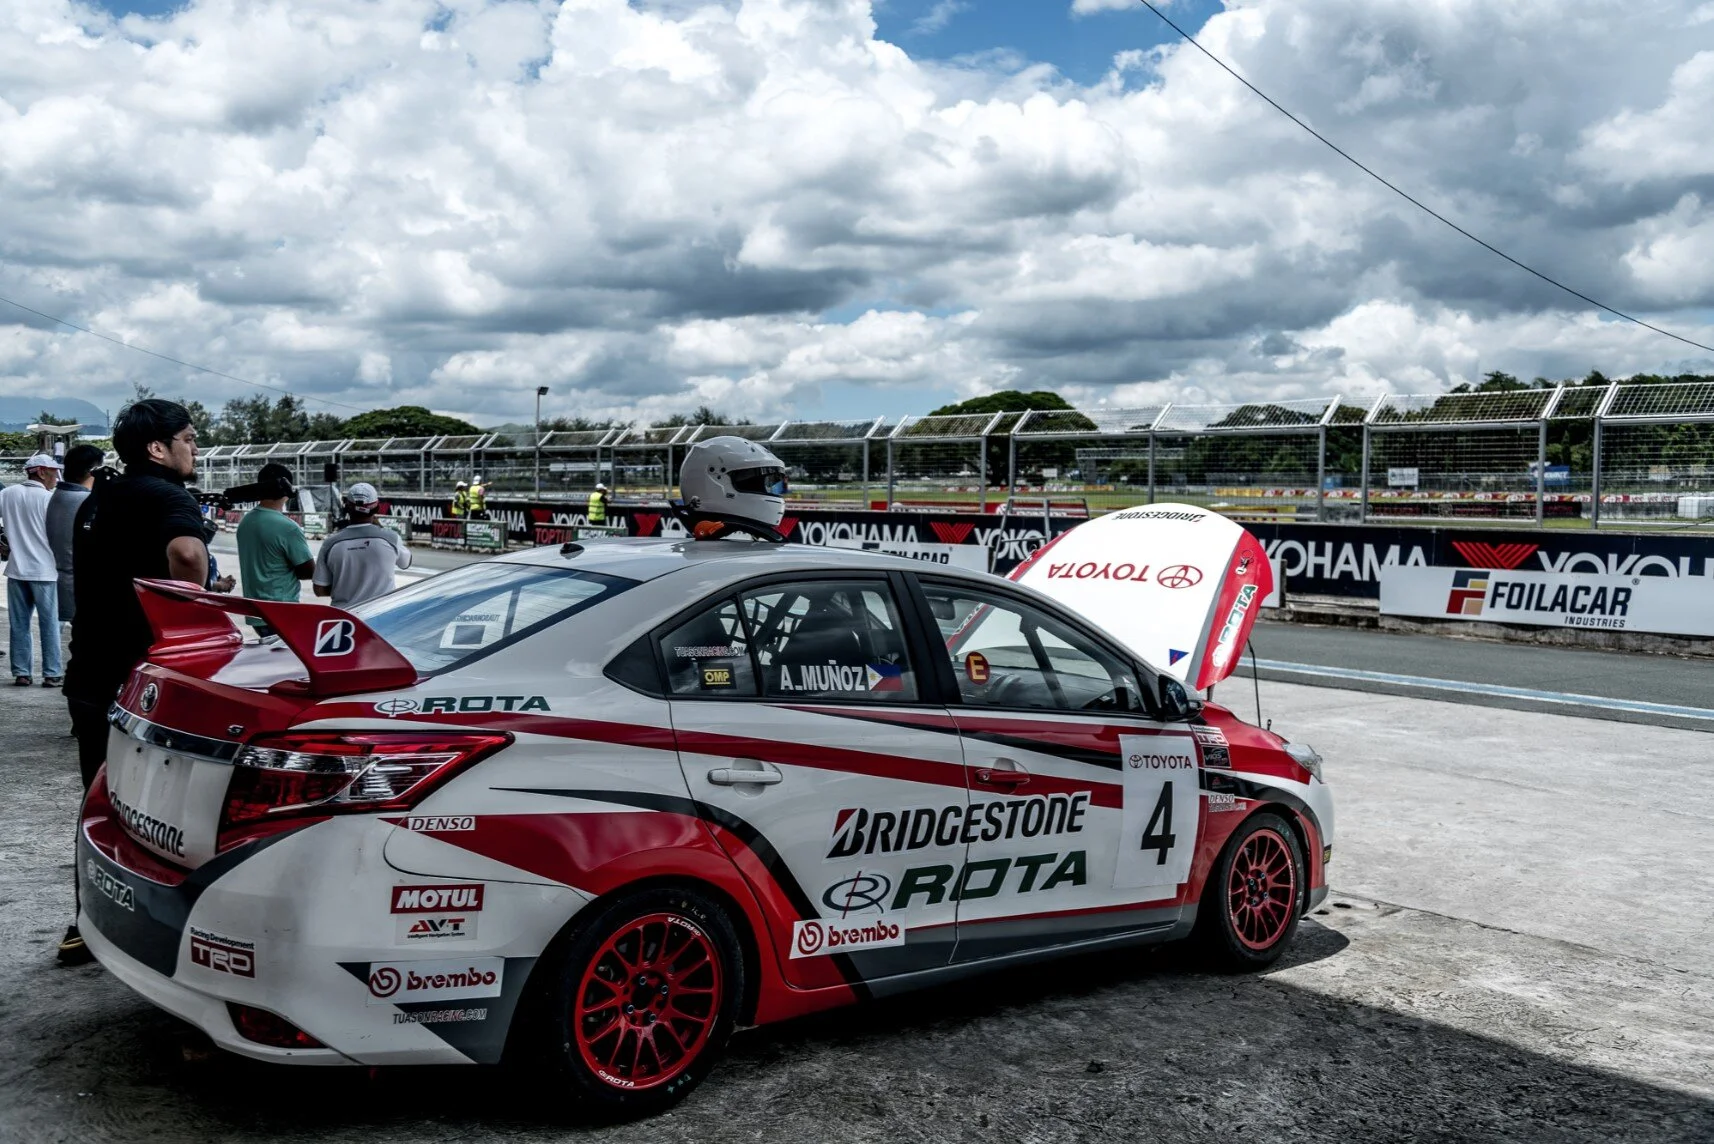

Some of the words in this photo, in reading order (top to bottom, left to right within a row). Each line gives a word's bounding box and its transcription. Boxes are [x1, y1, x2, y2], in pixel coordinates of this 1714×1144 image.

[1112, 511, 1206, 523] BRIDGESTONE
[798, 521, 920, 547] YOKOHAMA
[1048, 562, 1150, 582] TOYOTA
[1489, 581, 1633, 617] FOILACAR
[1564, 616, 1626, 629] INDUSTRIES
[705, 671, 730, 682] OMP
[970, 655, 987, 680] E
[421, 696, 552, 713] ROTA
[1143, 754, 1193, 770] TOYOTA
[1209, 794, 1235, 804] DENSO
[411, 817, 473, 831] DENSO
[827, 794, 1089, 859] BRIDGESTONE
[1141, 781, 1176, 866] 4
[94, 865, 135, 912] ROTA
[890, 850, 1087, 910] ROTA
[396, 888, 479, 909] MOTUL
[409, 918, 465, 932] AVT
[827, 920, 899, 948] brembo
[193, 942, 251, 974] TRD
[406, 966, 497, 991] brembo
[393, 1008, 488, 1025] TUASONRACING.COM
